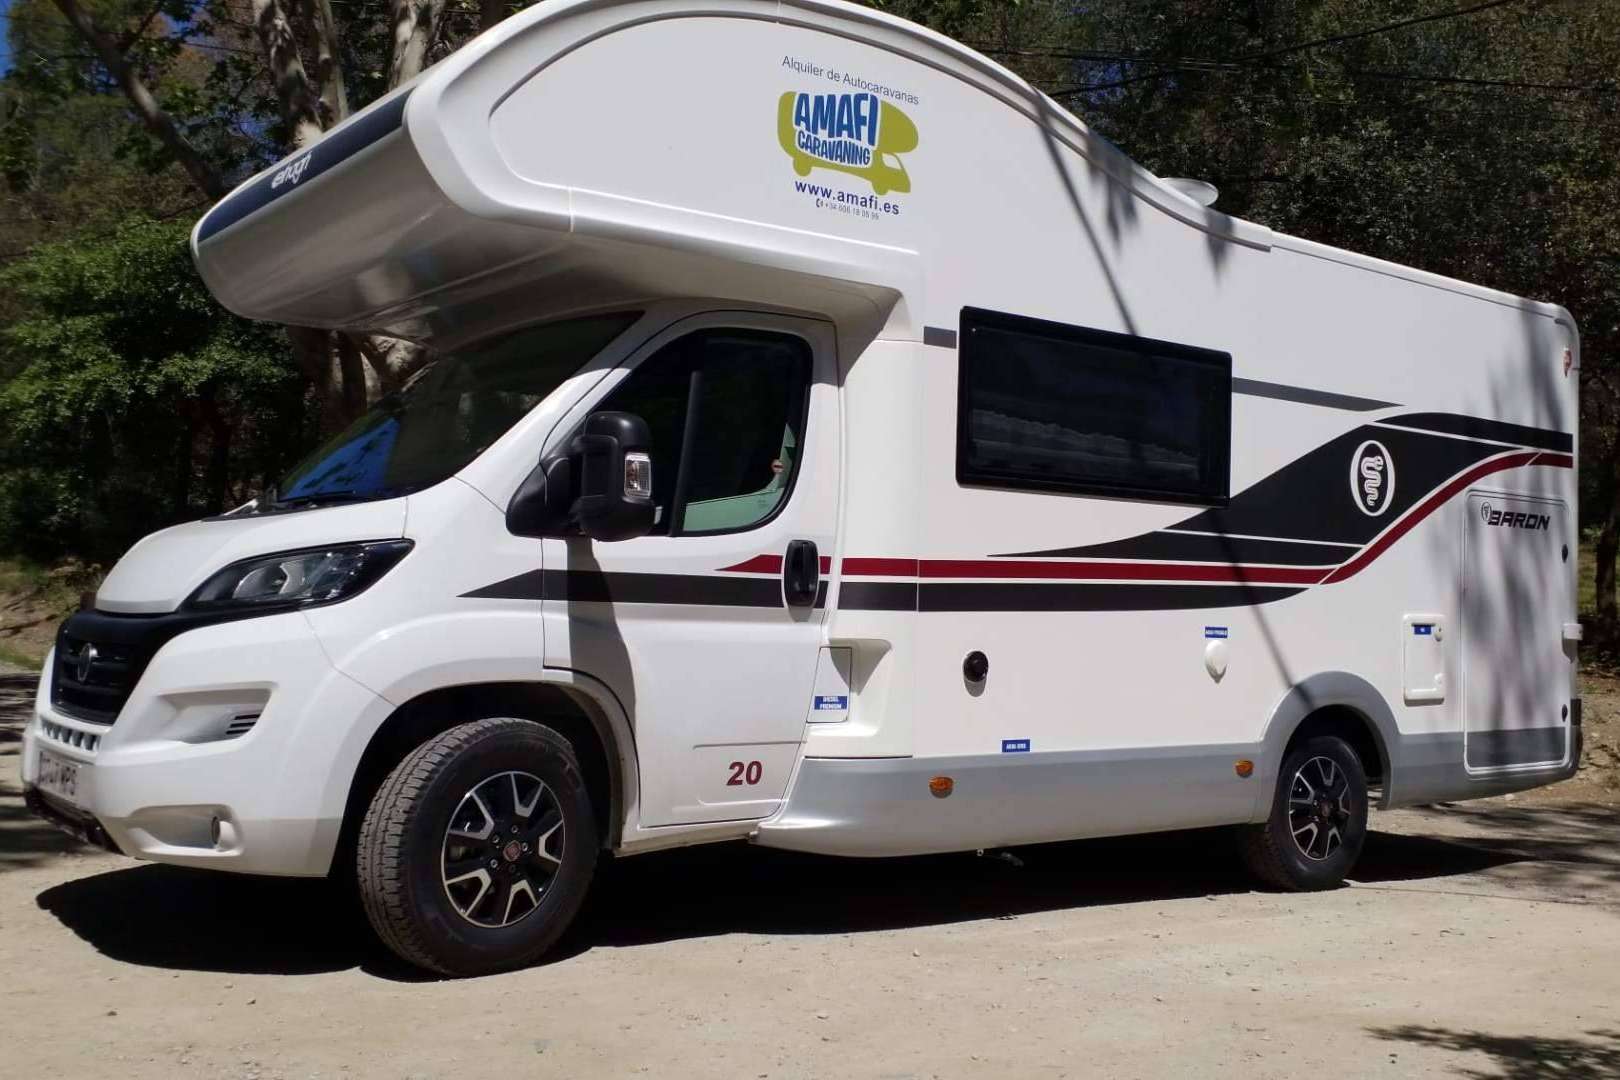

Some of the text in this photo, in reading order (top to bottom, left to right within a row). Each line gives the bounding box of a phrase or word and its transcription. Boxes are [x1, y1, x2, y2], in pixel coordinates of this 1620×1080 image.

[782, 55, 920, 105] Alquiler de Autocaravanas
[794, 92, 879, 147] AMAFI
[797, 130, 871, 166] CARAVANING
[794, 180, 900, 216] www.amafi.es
[1488, 510, 1550, 531] BARON
[726, 760, 762, 786] 20
